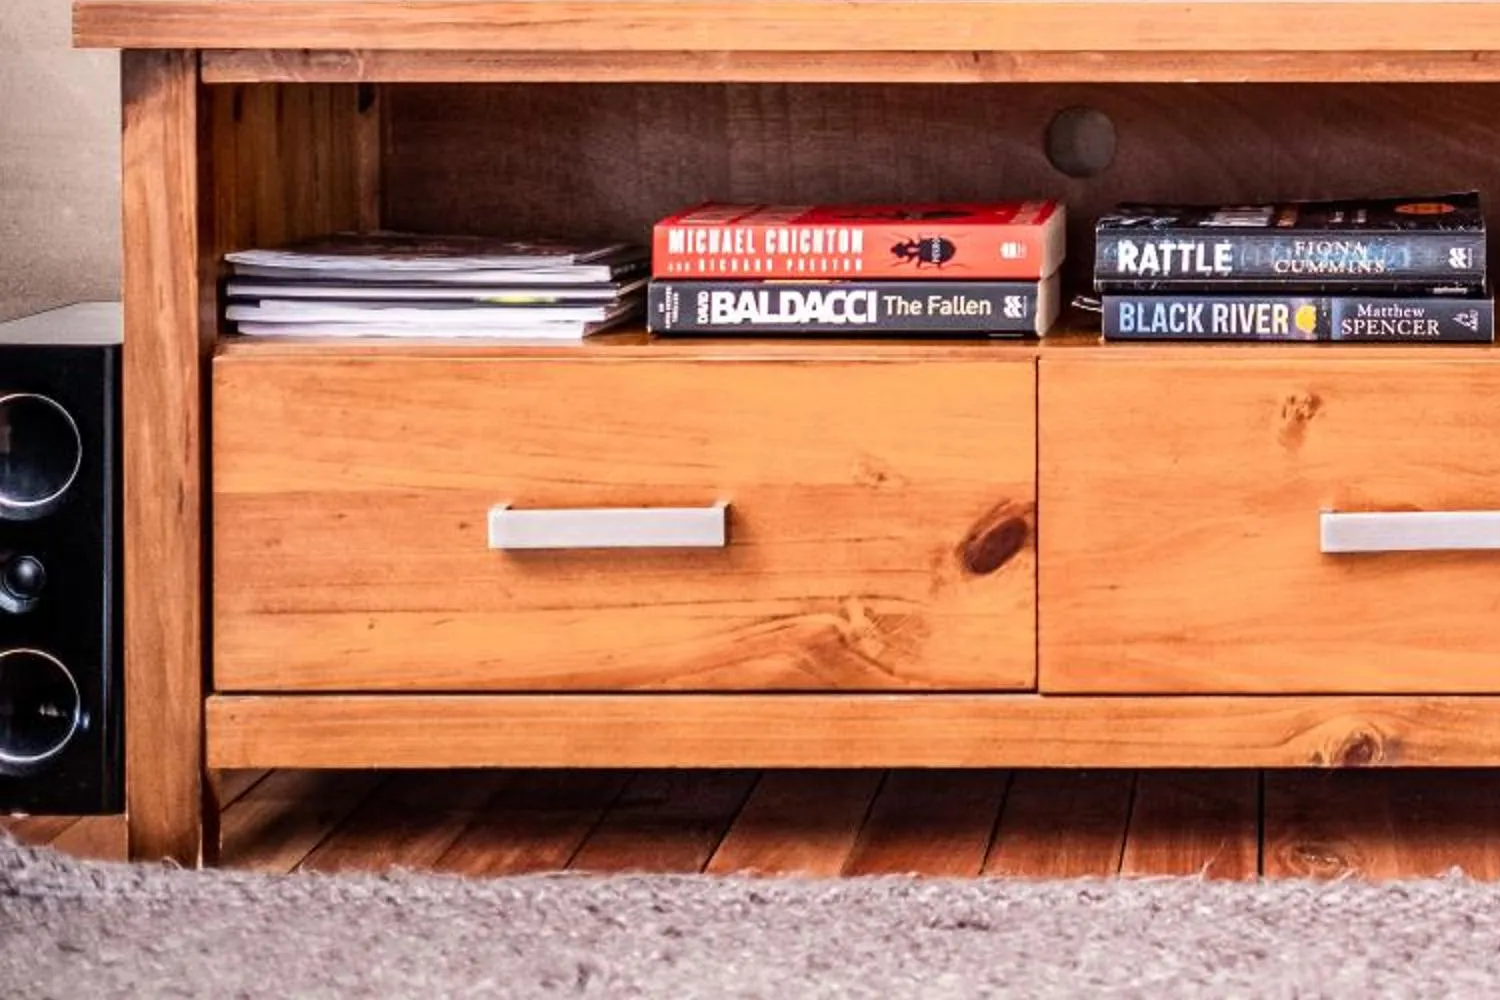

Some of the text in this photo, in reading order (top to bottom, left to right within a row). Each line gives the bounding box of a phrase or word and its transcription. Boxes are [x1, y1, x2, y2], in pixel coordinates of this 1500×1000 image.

[668, 229, 864, 254] MICHAEL CRICHTON
[1294, 240, 1367, 256] FIONA
[699, 258, 773, 272] RICHARD
[786, 258, 862, 272] PRESTON
[1117, 239, 1233, 277] RATTLE
[1274, 259, 1385, 273] CUMMINS
[711, 290, 992, 324] BALDACCI The Fallen
[1357, 303, 1425, 317] Matthew
[1119, 302, 1288, 334] BLACK RIVER
[1341, 320, 1440, 335] SPENCER
